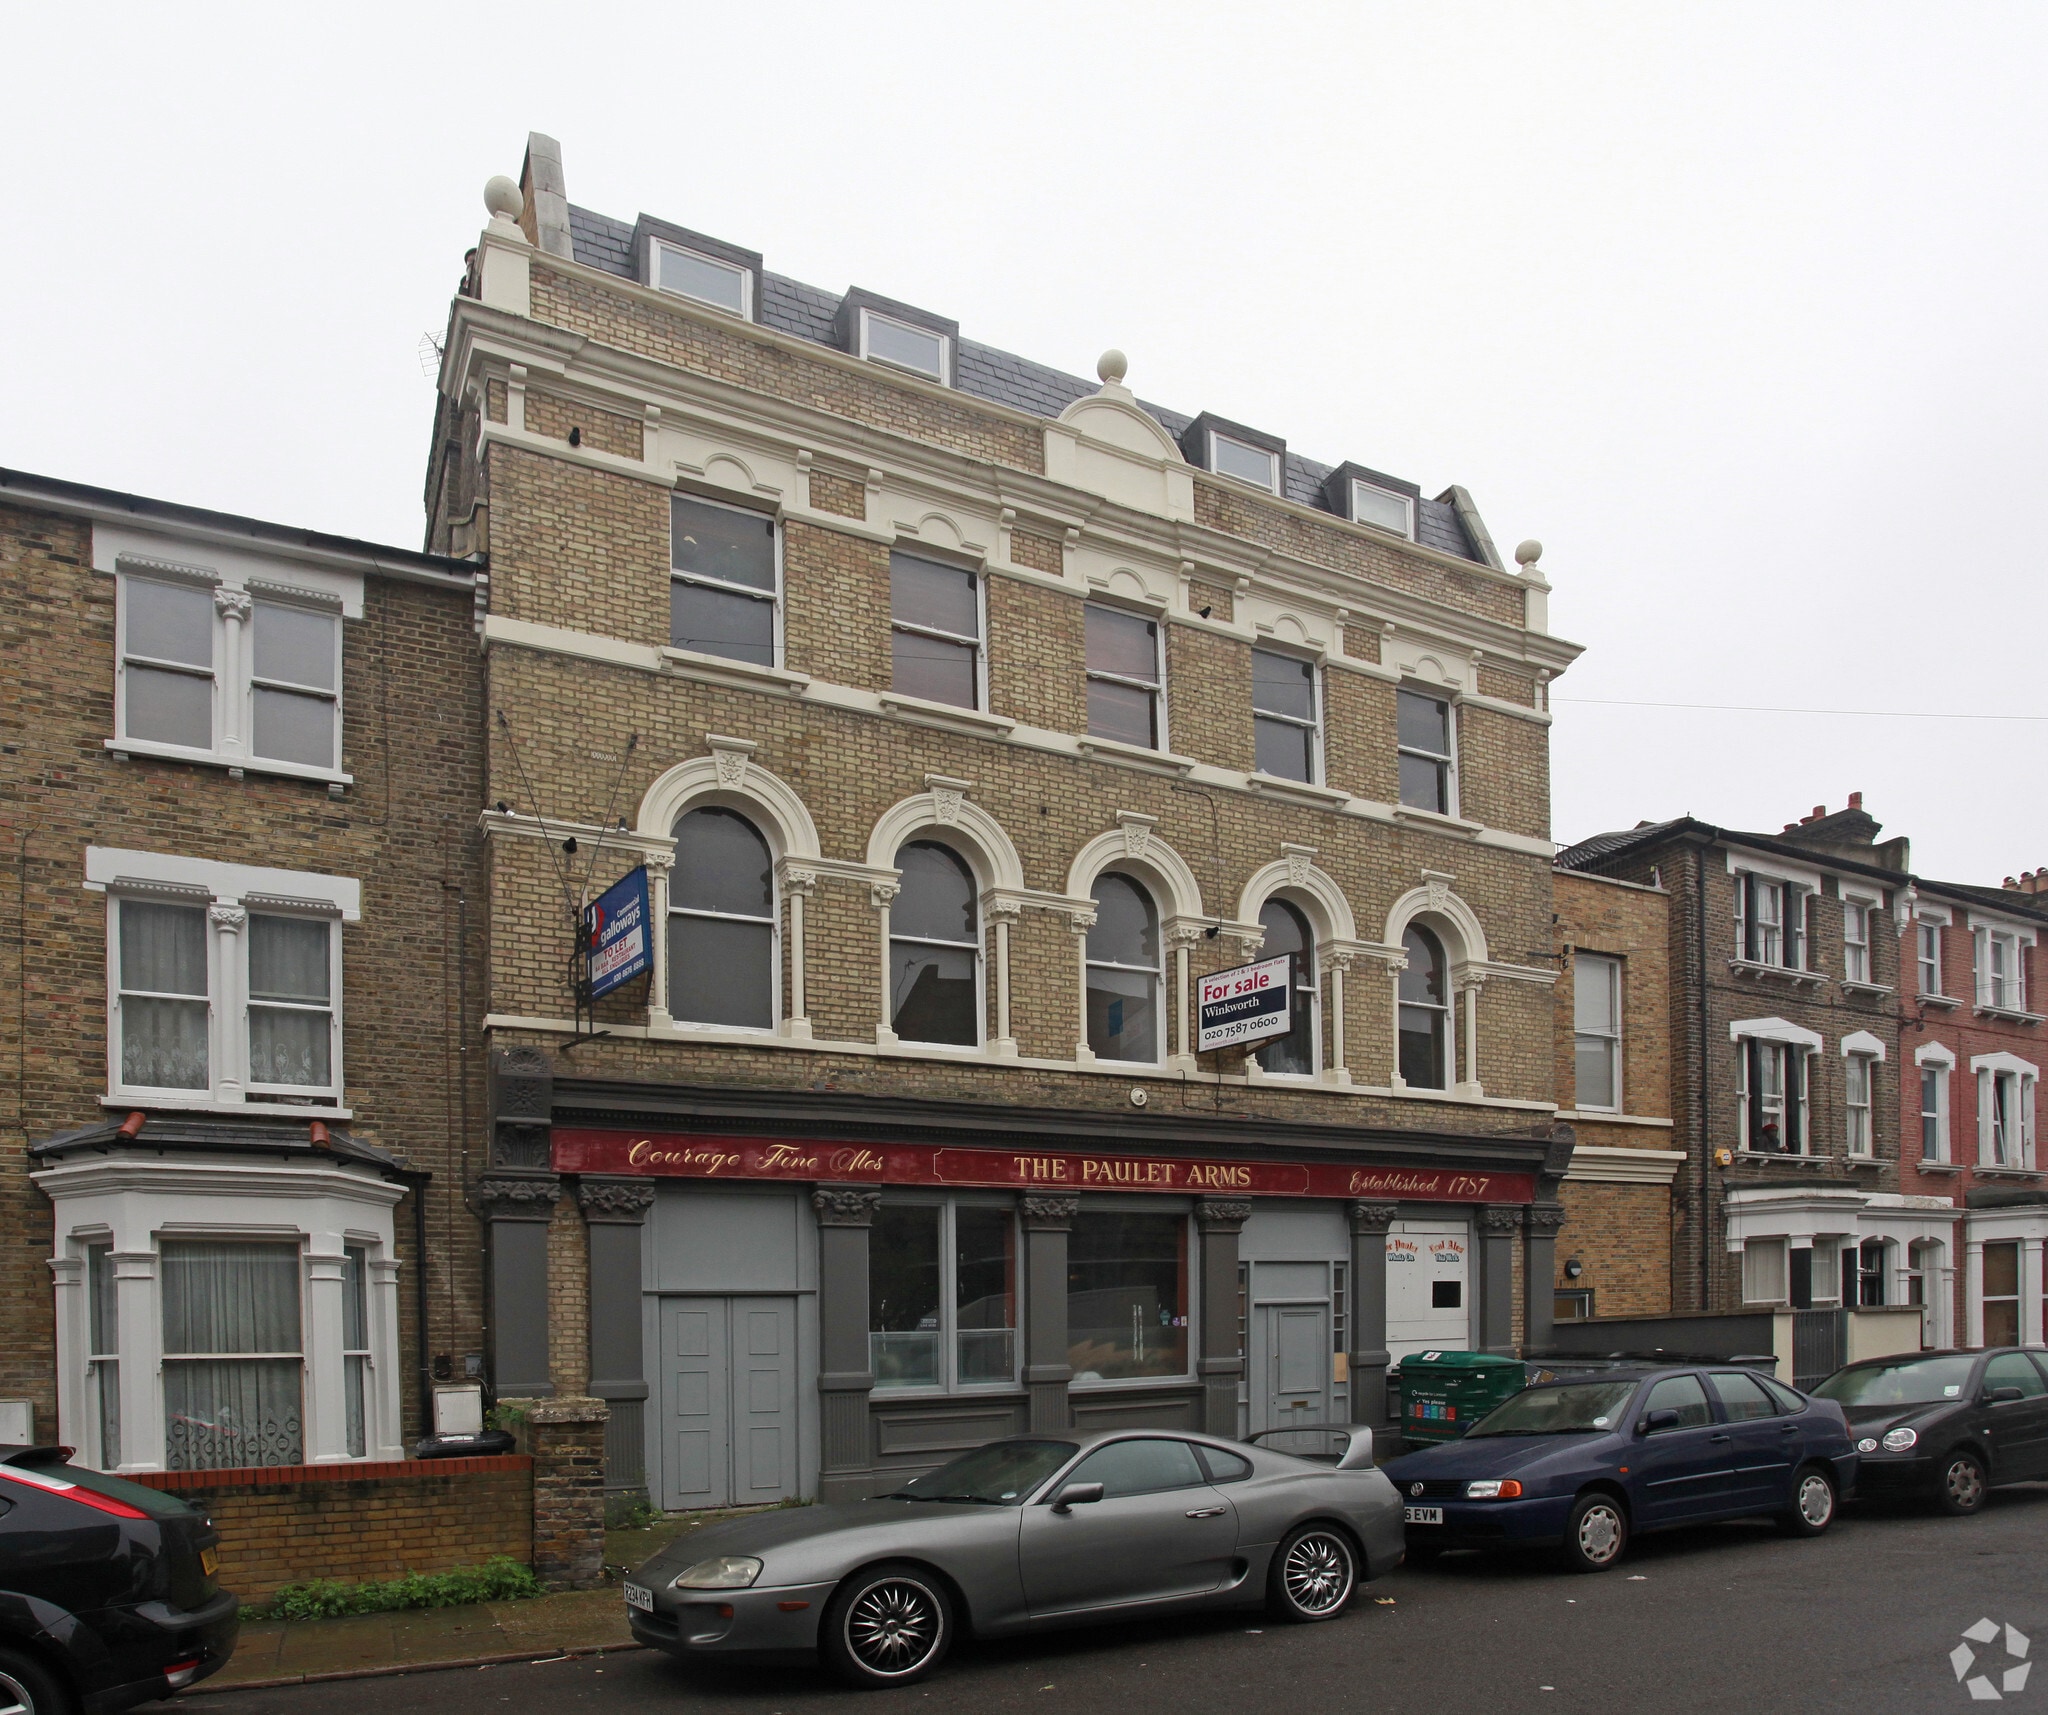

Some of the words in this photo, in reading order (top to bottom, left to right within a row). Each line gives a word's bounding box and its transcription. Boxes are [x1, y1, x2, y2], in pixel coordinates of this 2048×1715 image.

[600, 906, 640, 947] galloways
[603, 947, 613, 960] TO
[615, 937, 628, 954] LET
[1208, 973, 1230, 983] selection
[1250, 962, 1273, 972] bedroom
[1204, 984, 1230, 1002] For
[1235, 972, 1269, 994] sale
[1204, 996, 1260, 1018] Winkworth
[1204, 1029, 1223, 1040] 020
[1225, 1022, 1248, 1037] 7587
[1249, 1016, 1278, 1030] 0600
[628, 1138, 740, 1174] Courage
[755, 1144, 818, 1169] Fine
[830, 1147, 884, 1172] Ales
[1013, 1157, 1067, 1181] THE
[1082, 1160, 1176, 1183] PAULET
[1186, 1164, 1251, 1189] ARMS
[1350, 1171, 1440, 1194] Established
[1448, 1176, 1491, 1195] 1787
[1414, 1508, 1437, 1521] EVM
